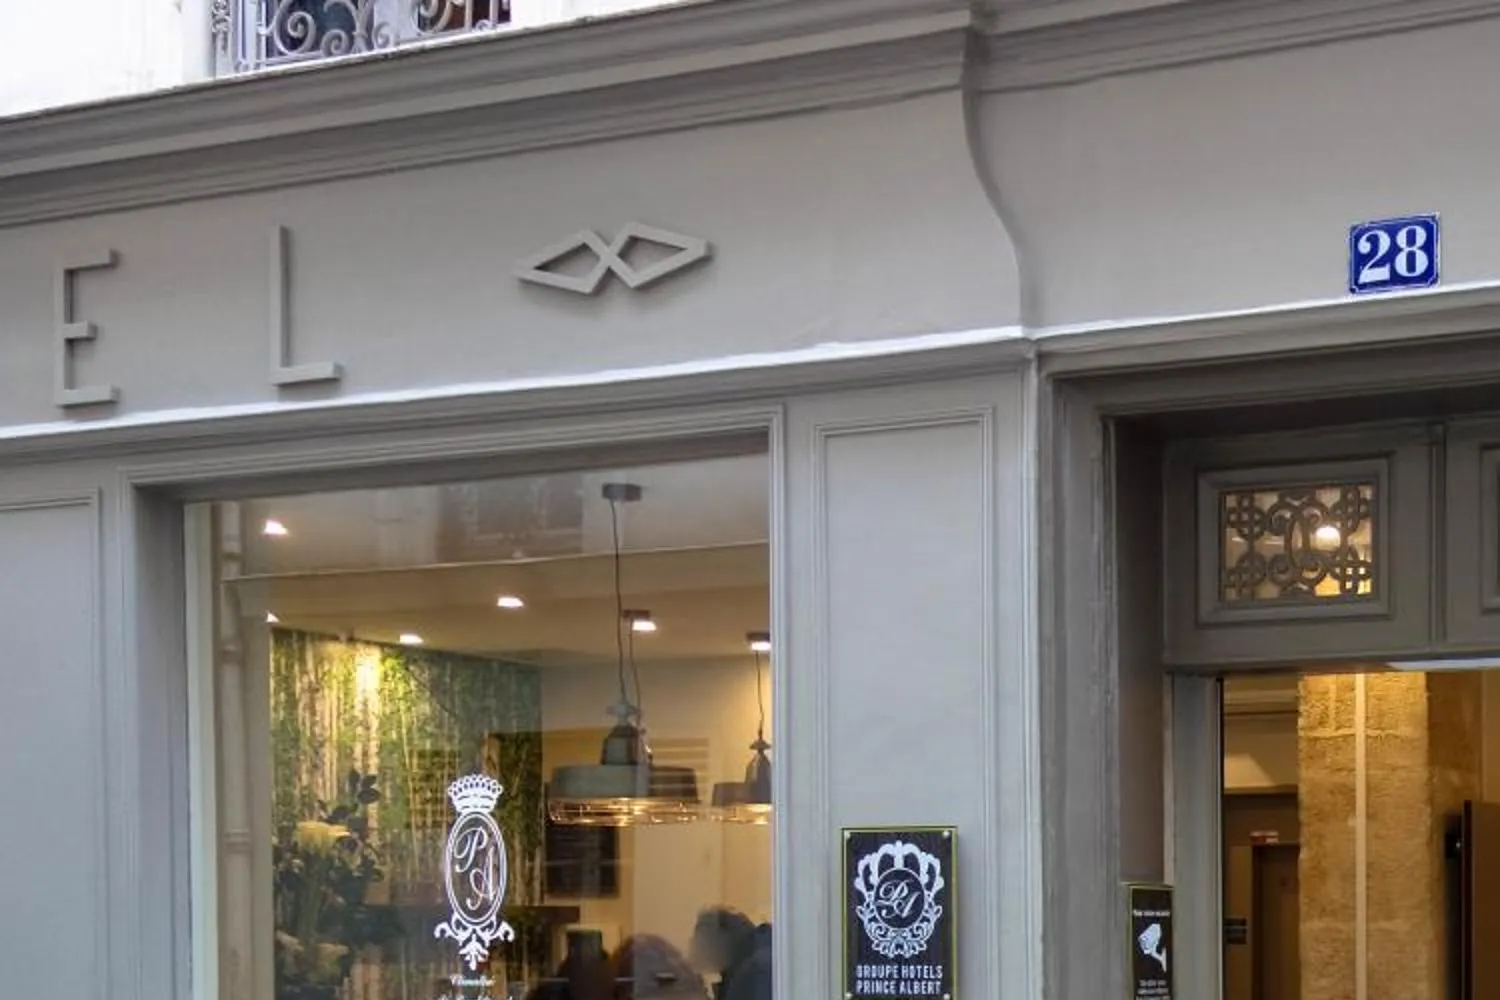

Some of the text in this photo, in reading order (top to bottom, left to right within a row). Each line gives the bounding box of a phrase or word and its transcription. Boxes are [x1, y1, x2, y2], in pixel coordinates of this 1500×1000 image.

[1358, 225, 1429, 285] 28
[856, 964, 943, 979] GROUPE HOTELS
[856, 980, 941, 994] PRINCE ALBERT
